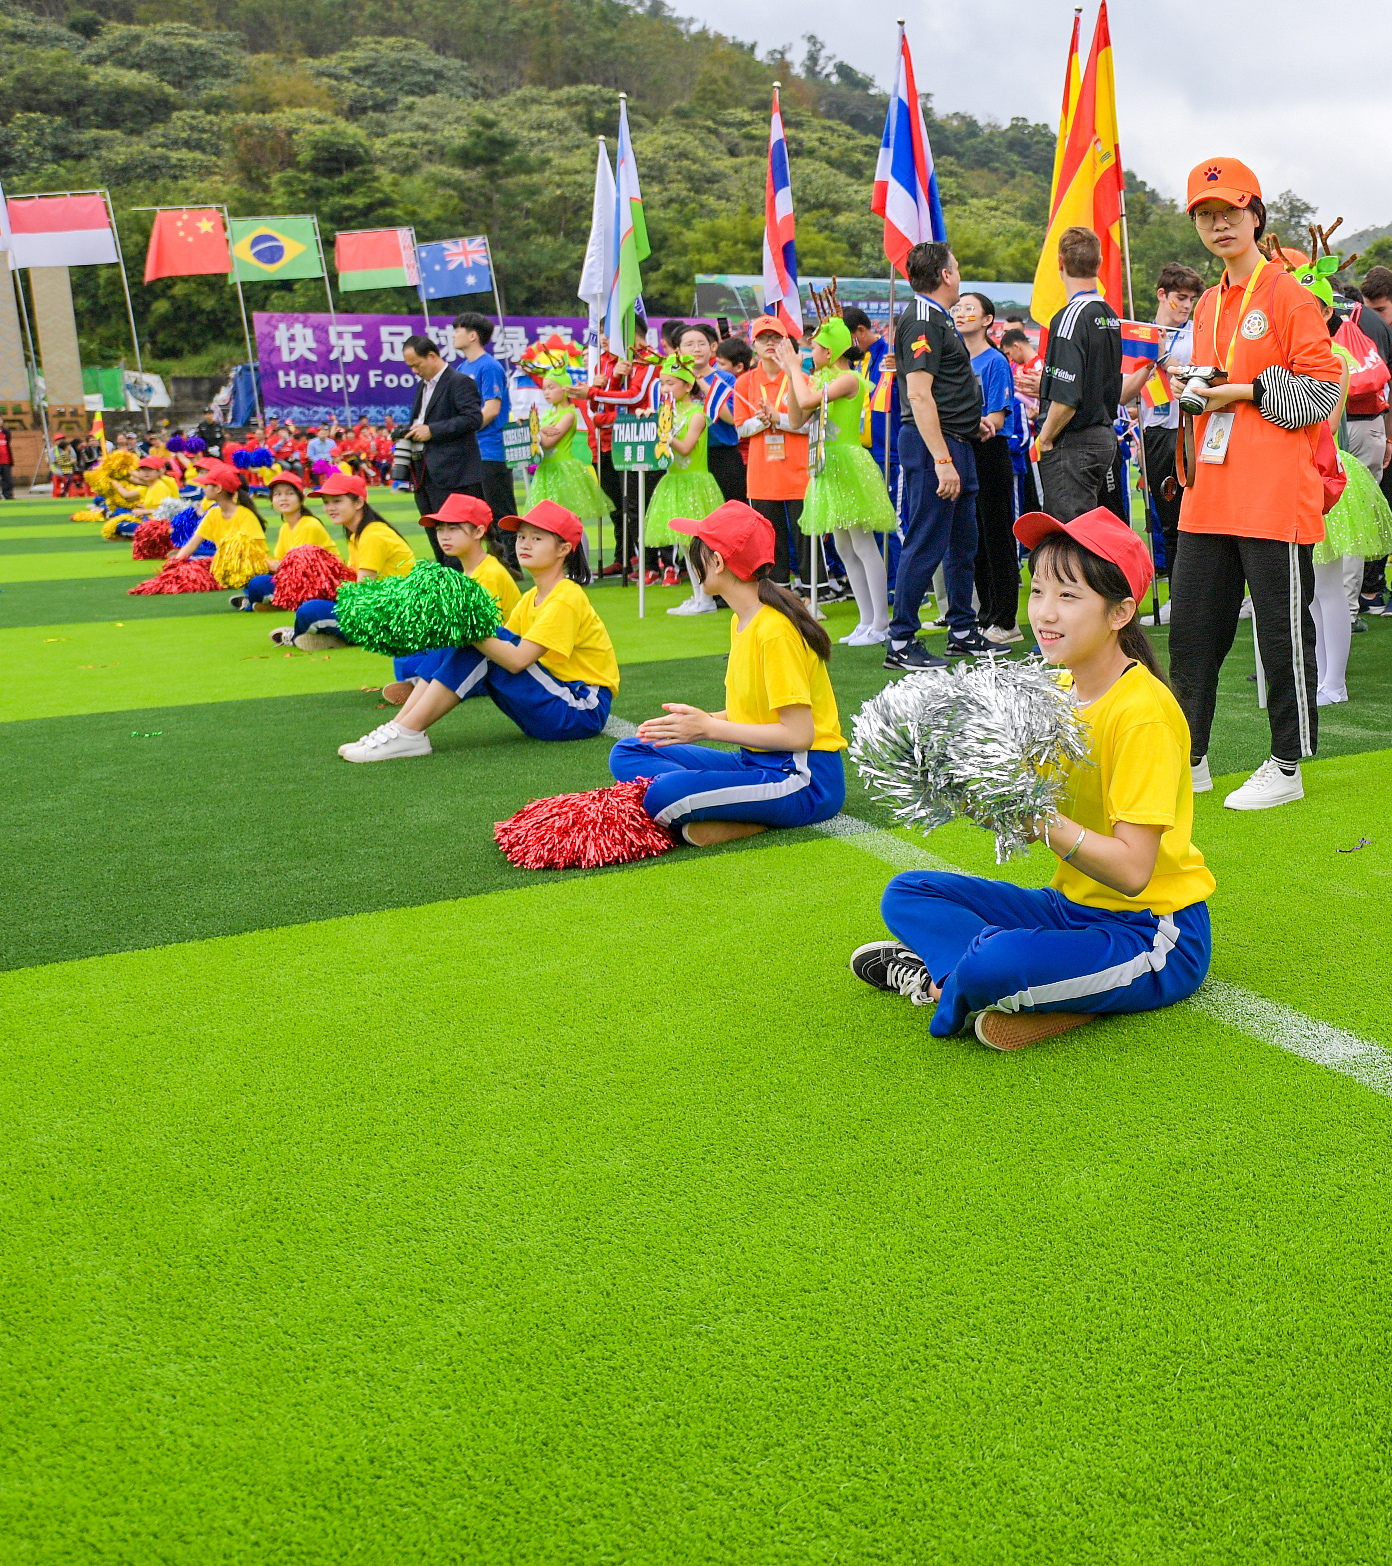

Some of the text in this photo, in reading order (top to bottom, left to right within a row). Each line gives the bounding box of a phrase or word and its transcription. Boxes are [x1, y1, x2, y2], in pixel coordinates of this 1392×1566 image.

[278, 369, 421, 393] Happy Foo
[613, 421, 657, 443] THAILAND
[624, 444, 645, 463] 泰国
